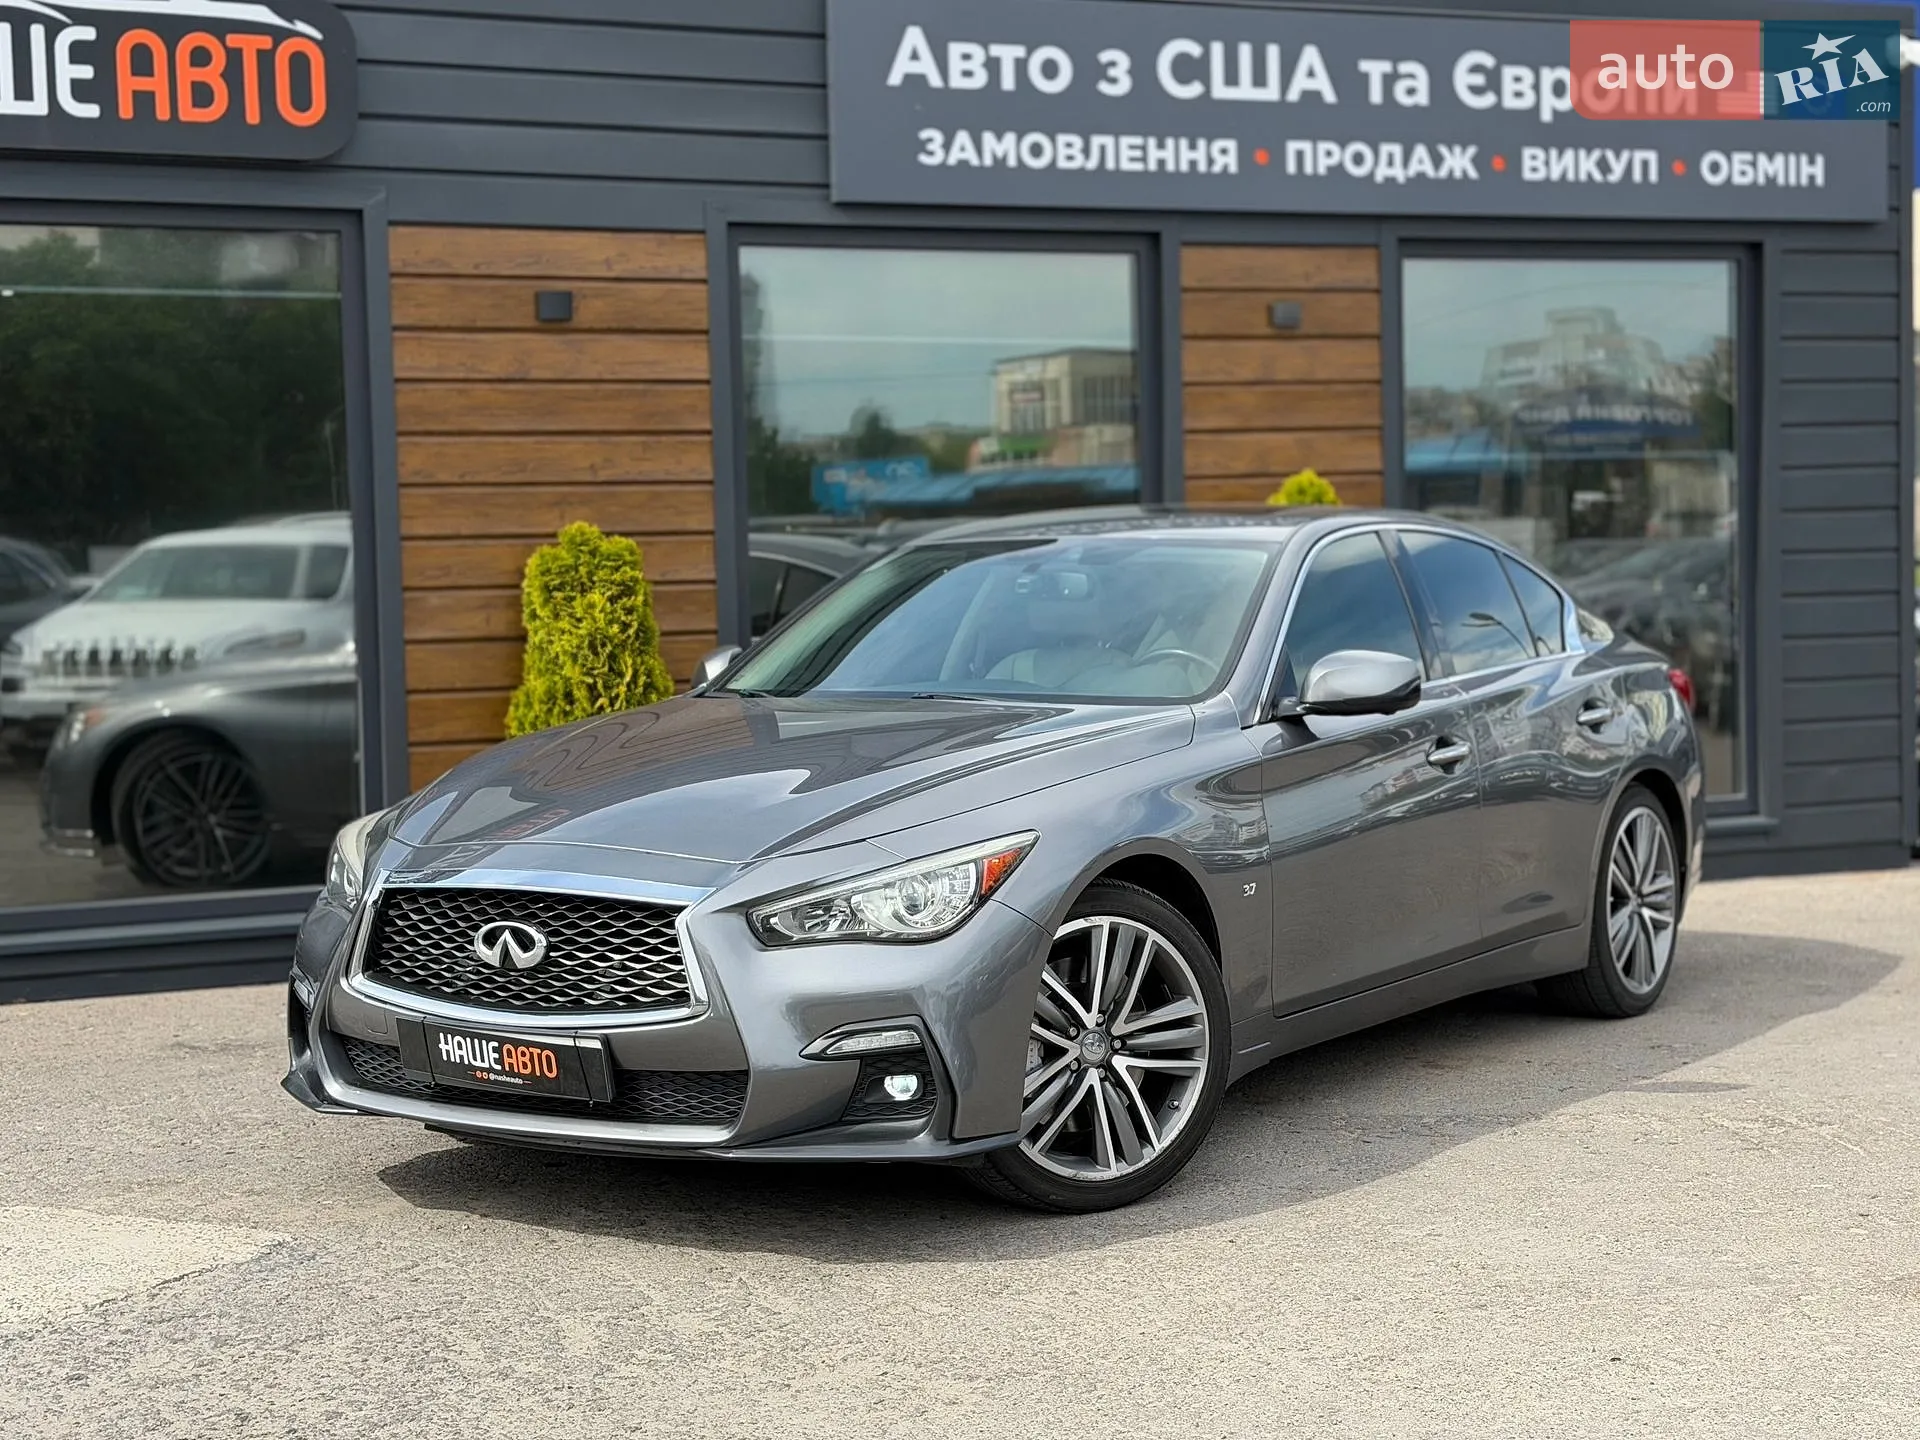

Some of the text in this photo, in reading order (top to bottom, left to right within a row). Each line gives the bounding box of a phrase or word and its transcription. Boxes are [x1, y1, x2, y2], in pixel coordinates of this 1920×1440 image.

[115, 28, 327, 127] АВТО
[886, 25, 1074, 95] Авто
[1096, 48, 1133, 97] з
[1156, 37, 1338, 105] США
[1358, 58, 1431, 108] та
[916, 127, 1825, 187] ЗАМОВЛЕННЯ ПРОДАЖ ВИКУП ОБМІН
[438, 1032, 557, 1079] НАШЕ АВТО
